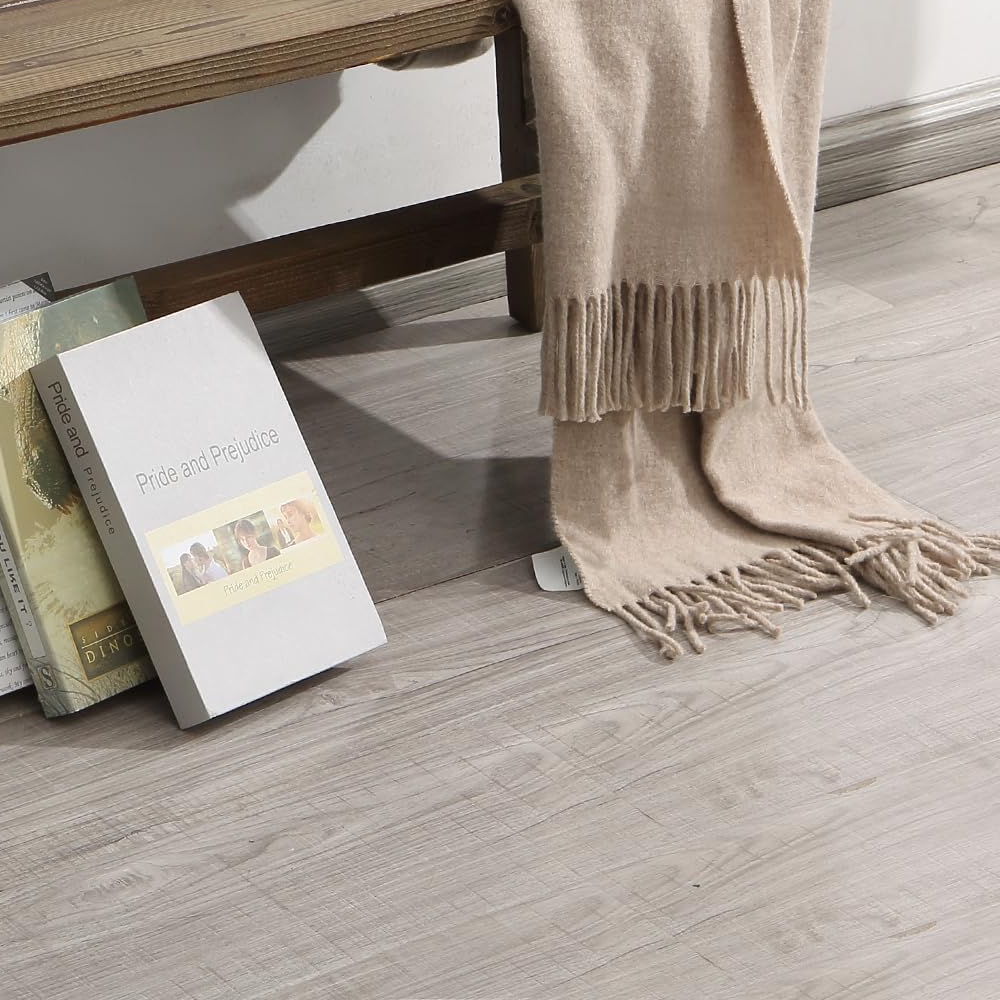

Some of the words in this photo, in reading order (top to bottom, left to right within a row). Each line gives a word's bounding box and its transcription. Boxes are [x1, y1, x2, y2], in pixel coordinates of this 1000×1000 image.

[48, 381, 72, 425] Pride
[66, 427, 89, 458] and
[83, 467, 115, 535] Prejudice
[136, 465, 179, 495] Pride
[180, 450, 210, 478] and
[209, 428, 280, 463] Prejudice
[18, 599, 28, 614] IT
[223, 581, 244, 597] Pride
[244, 575, 260, 588] and
